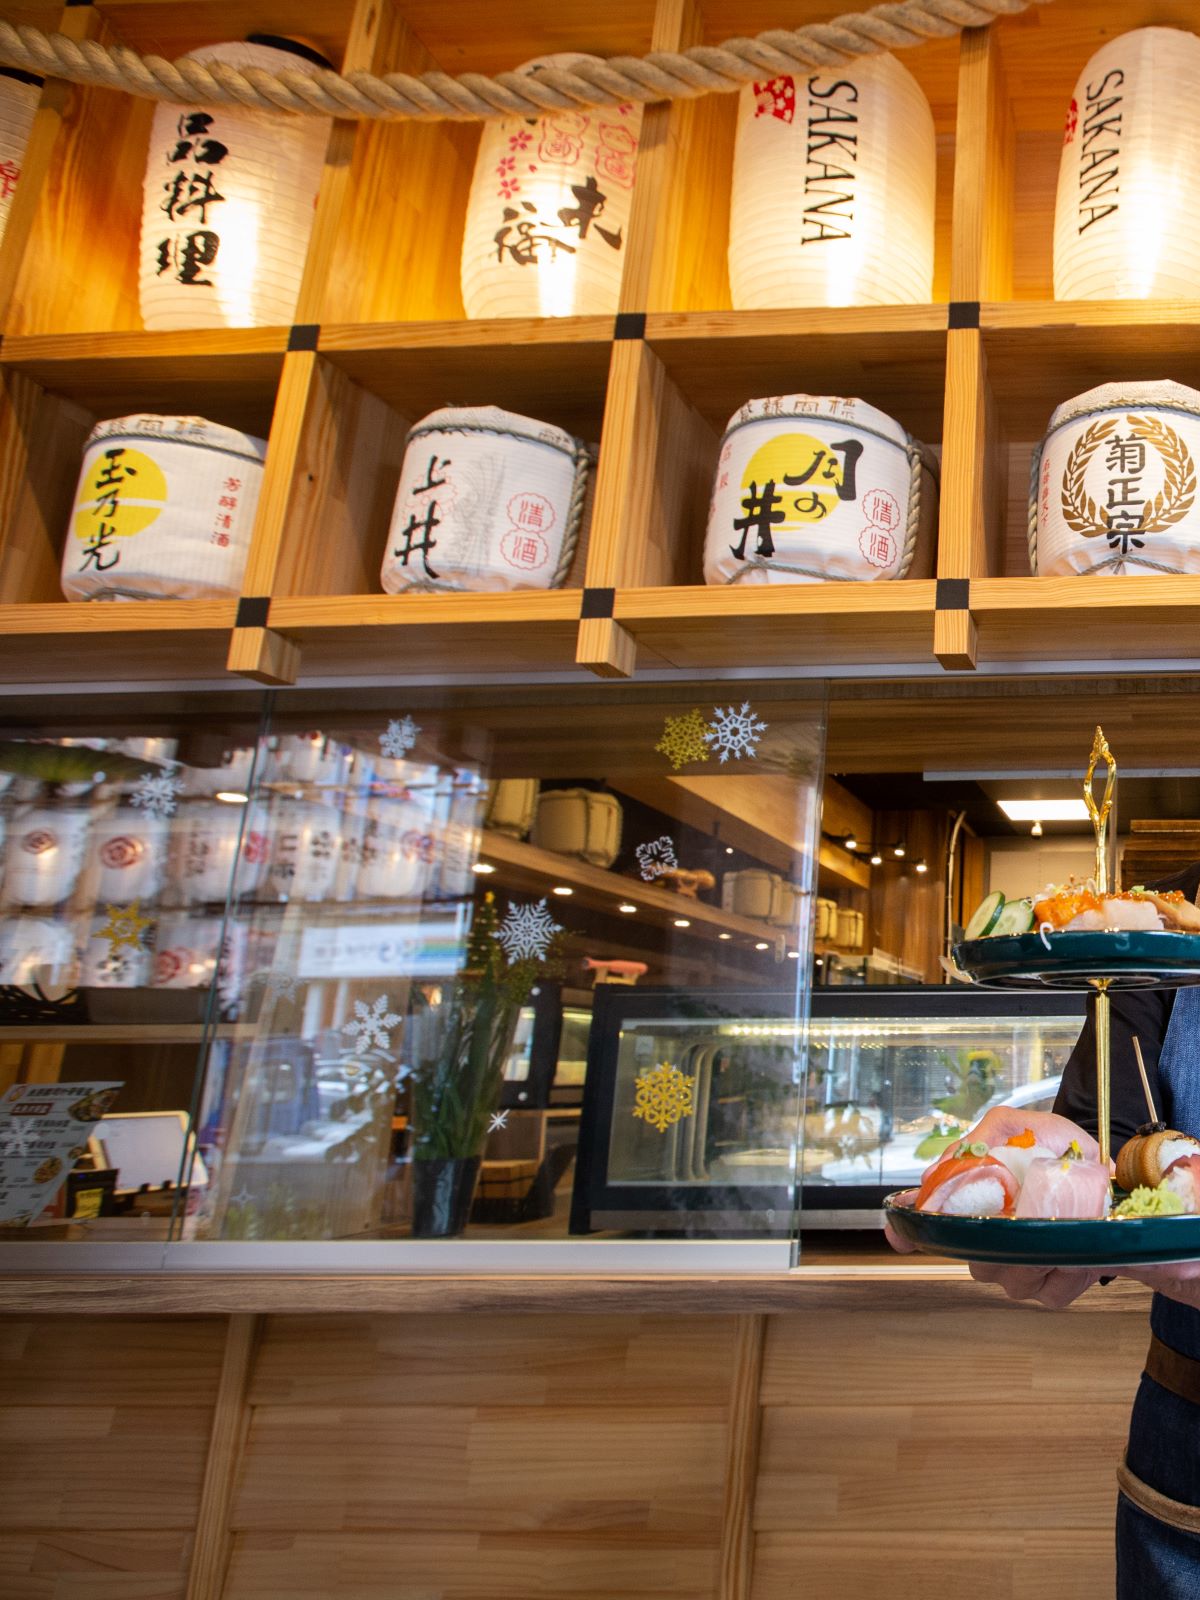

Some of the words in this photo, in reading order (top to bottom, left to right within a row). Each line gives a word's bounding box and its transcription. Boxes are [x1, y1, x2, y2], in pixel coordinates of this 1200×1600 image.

[800, 75, 859, 246] SAKANA
[1078, 68, 1125, 236] SAKANA
[78, 448, 138, 572] 玉乃光
[512, 499, 545, 564] 清酒
[869, 496, 893, 562] 清酒
[1104, 432, 1148, 555] 菊正宗
